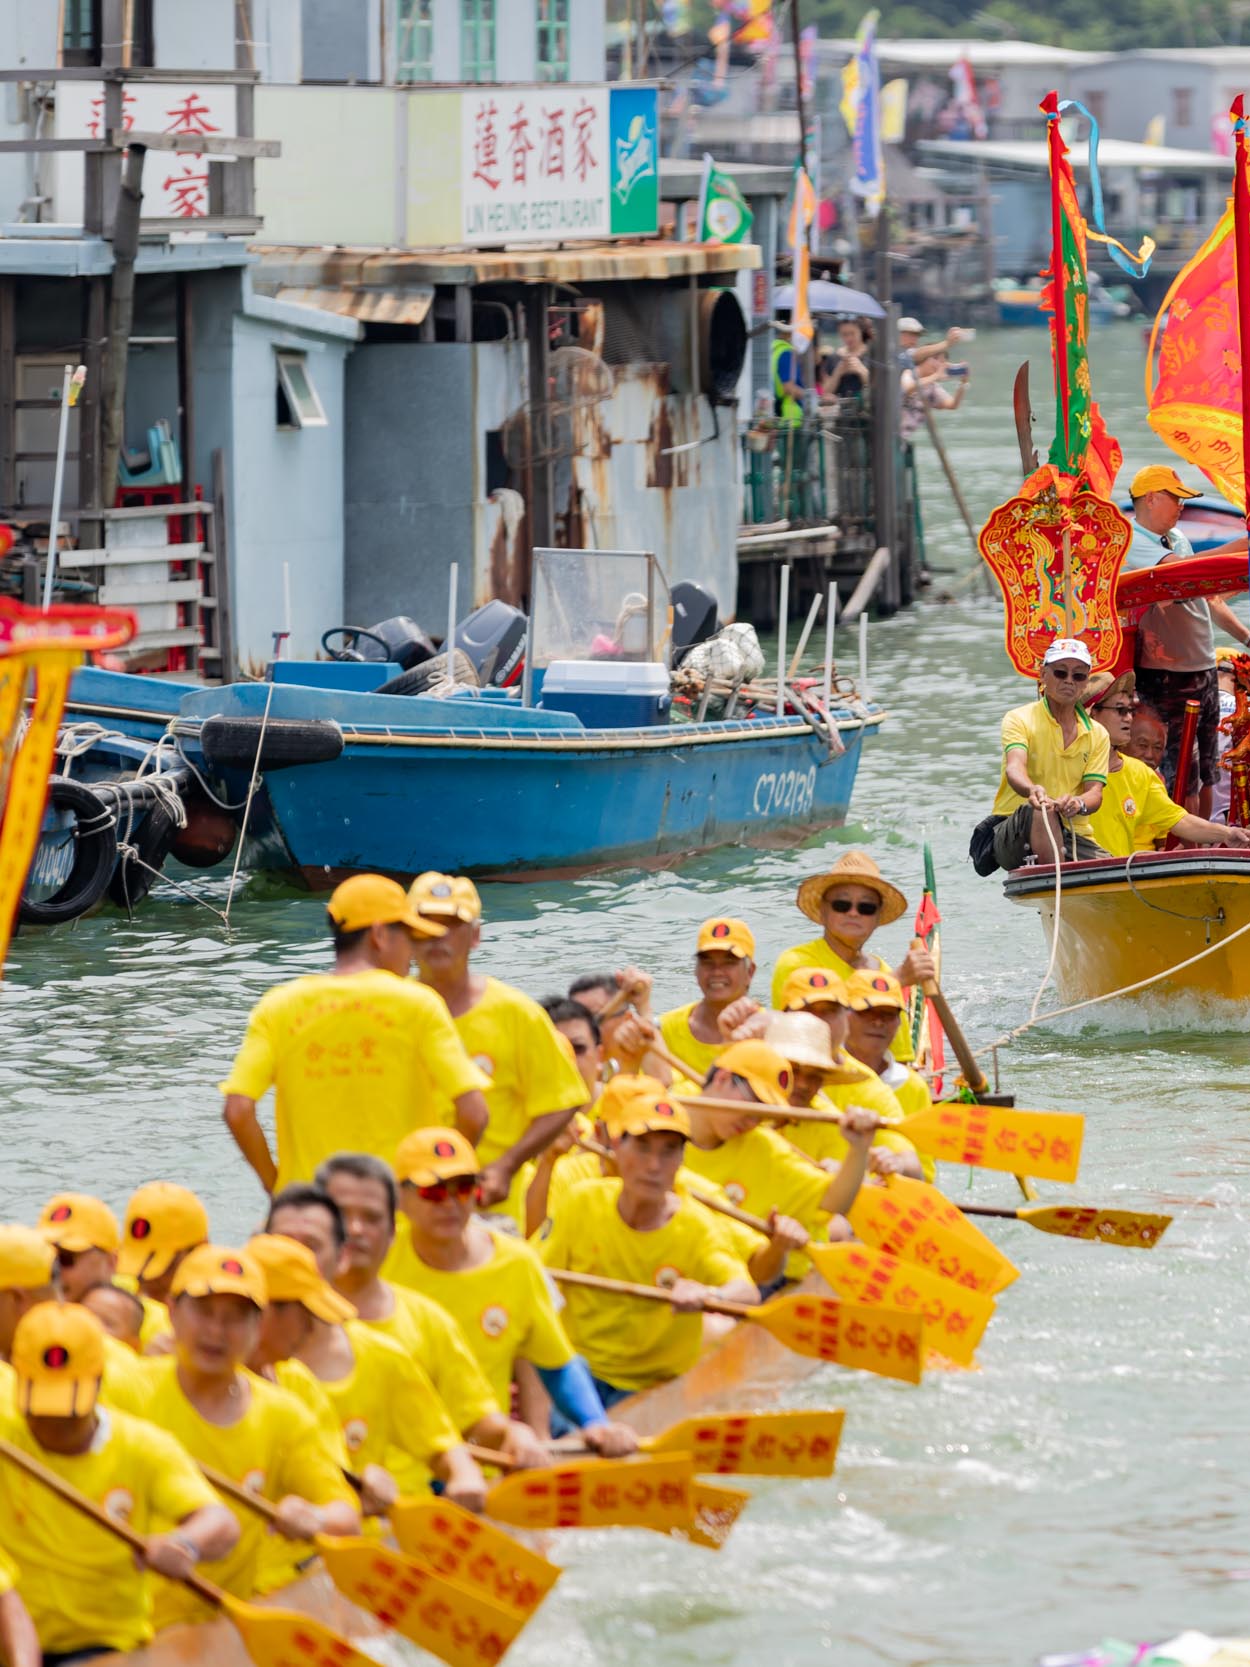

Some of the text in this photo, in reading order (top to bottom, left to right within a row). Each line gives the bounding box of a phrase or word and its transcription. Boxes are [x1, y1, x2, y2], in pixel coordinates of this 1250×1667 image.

[472, 97, 598, 190] 蓮香酒家
[466, 198, 604, 234] LIN HEUNG RESTAURANT
